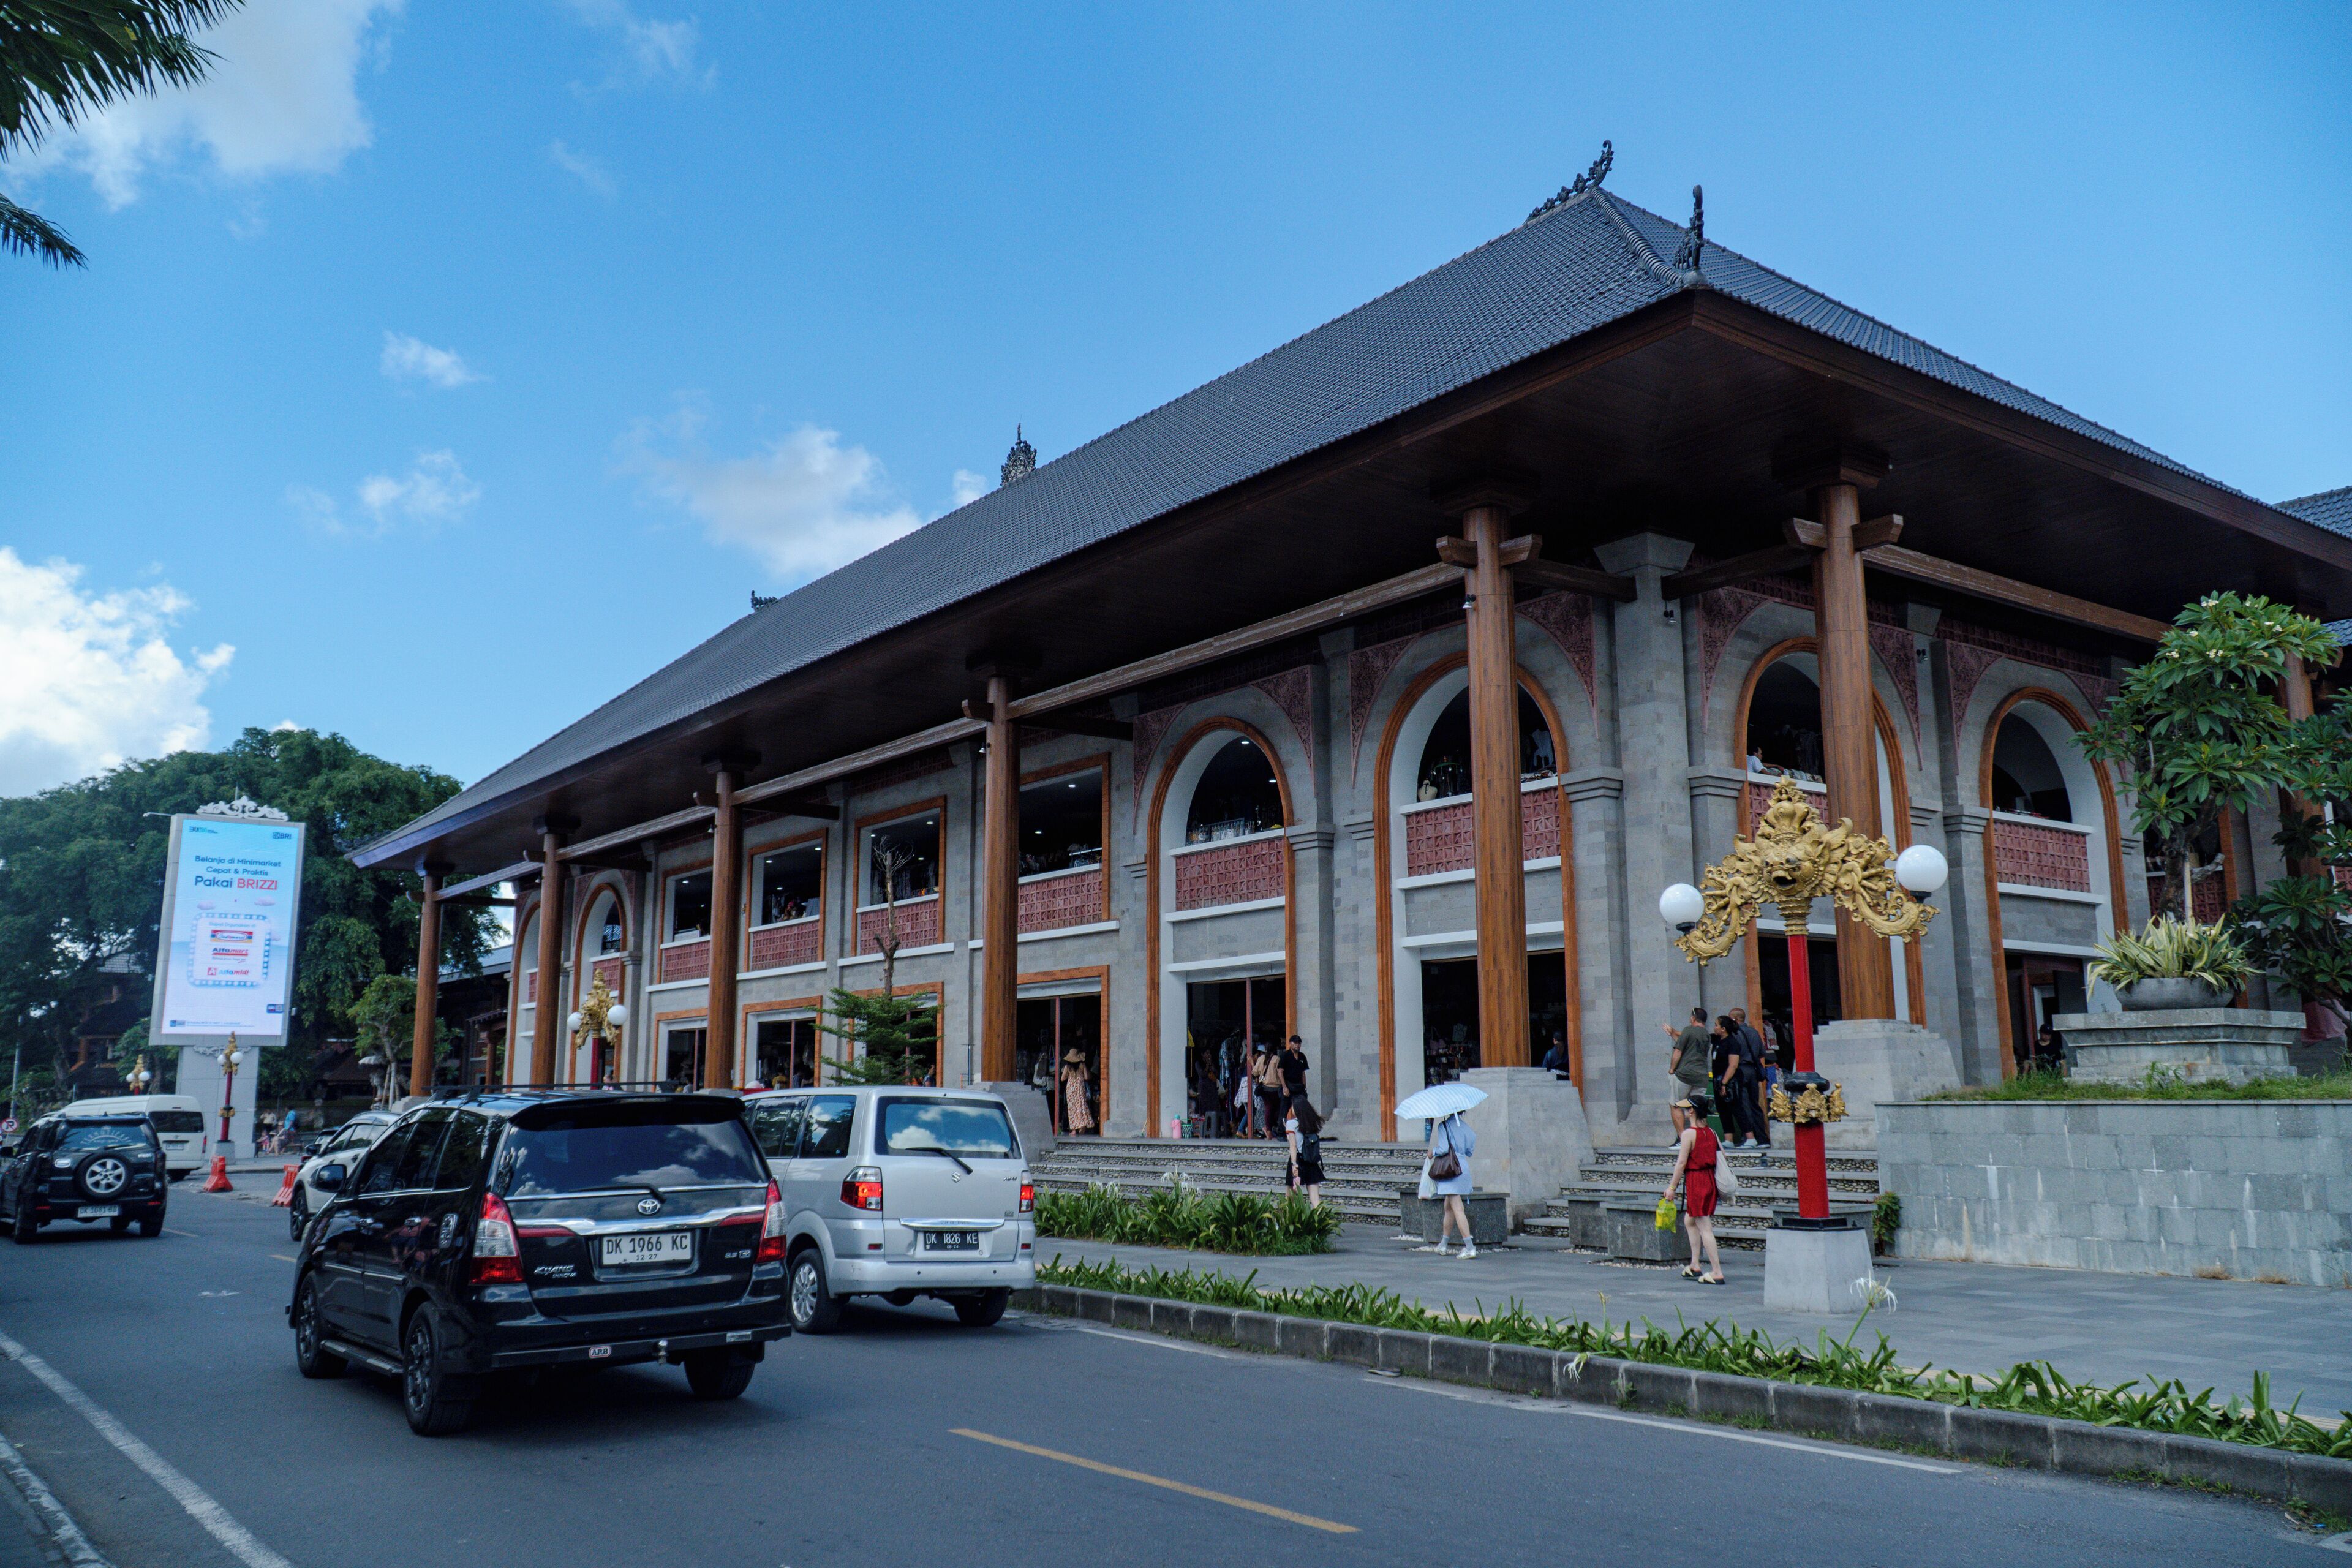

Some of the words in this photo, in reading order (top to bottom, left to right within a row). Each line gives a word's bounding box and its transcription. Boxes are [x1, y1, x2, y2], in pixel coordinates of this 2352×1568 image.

[195, 856, 225, 864] Belanja
[195, 876, 233, 888] Pakai
[237, 878, 277, 890] BRIZZI
[606, 1238, 622, 1254] DK
[629, 1236, 662, 1253] 1966
[671, 1235, 687, 1251] KC
[925, 1233, 937, 1244] DK
[943, 1233, 960, 1244] 1826
[967, 1232, 978, 1244] KE
